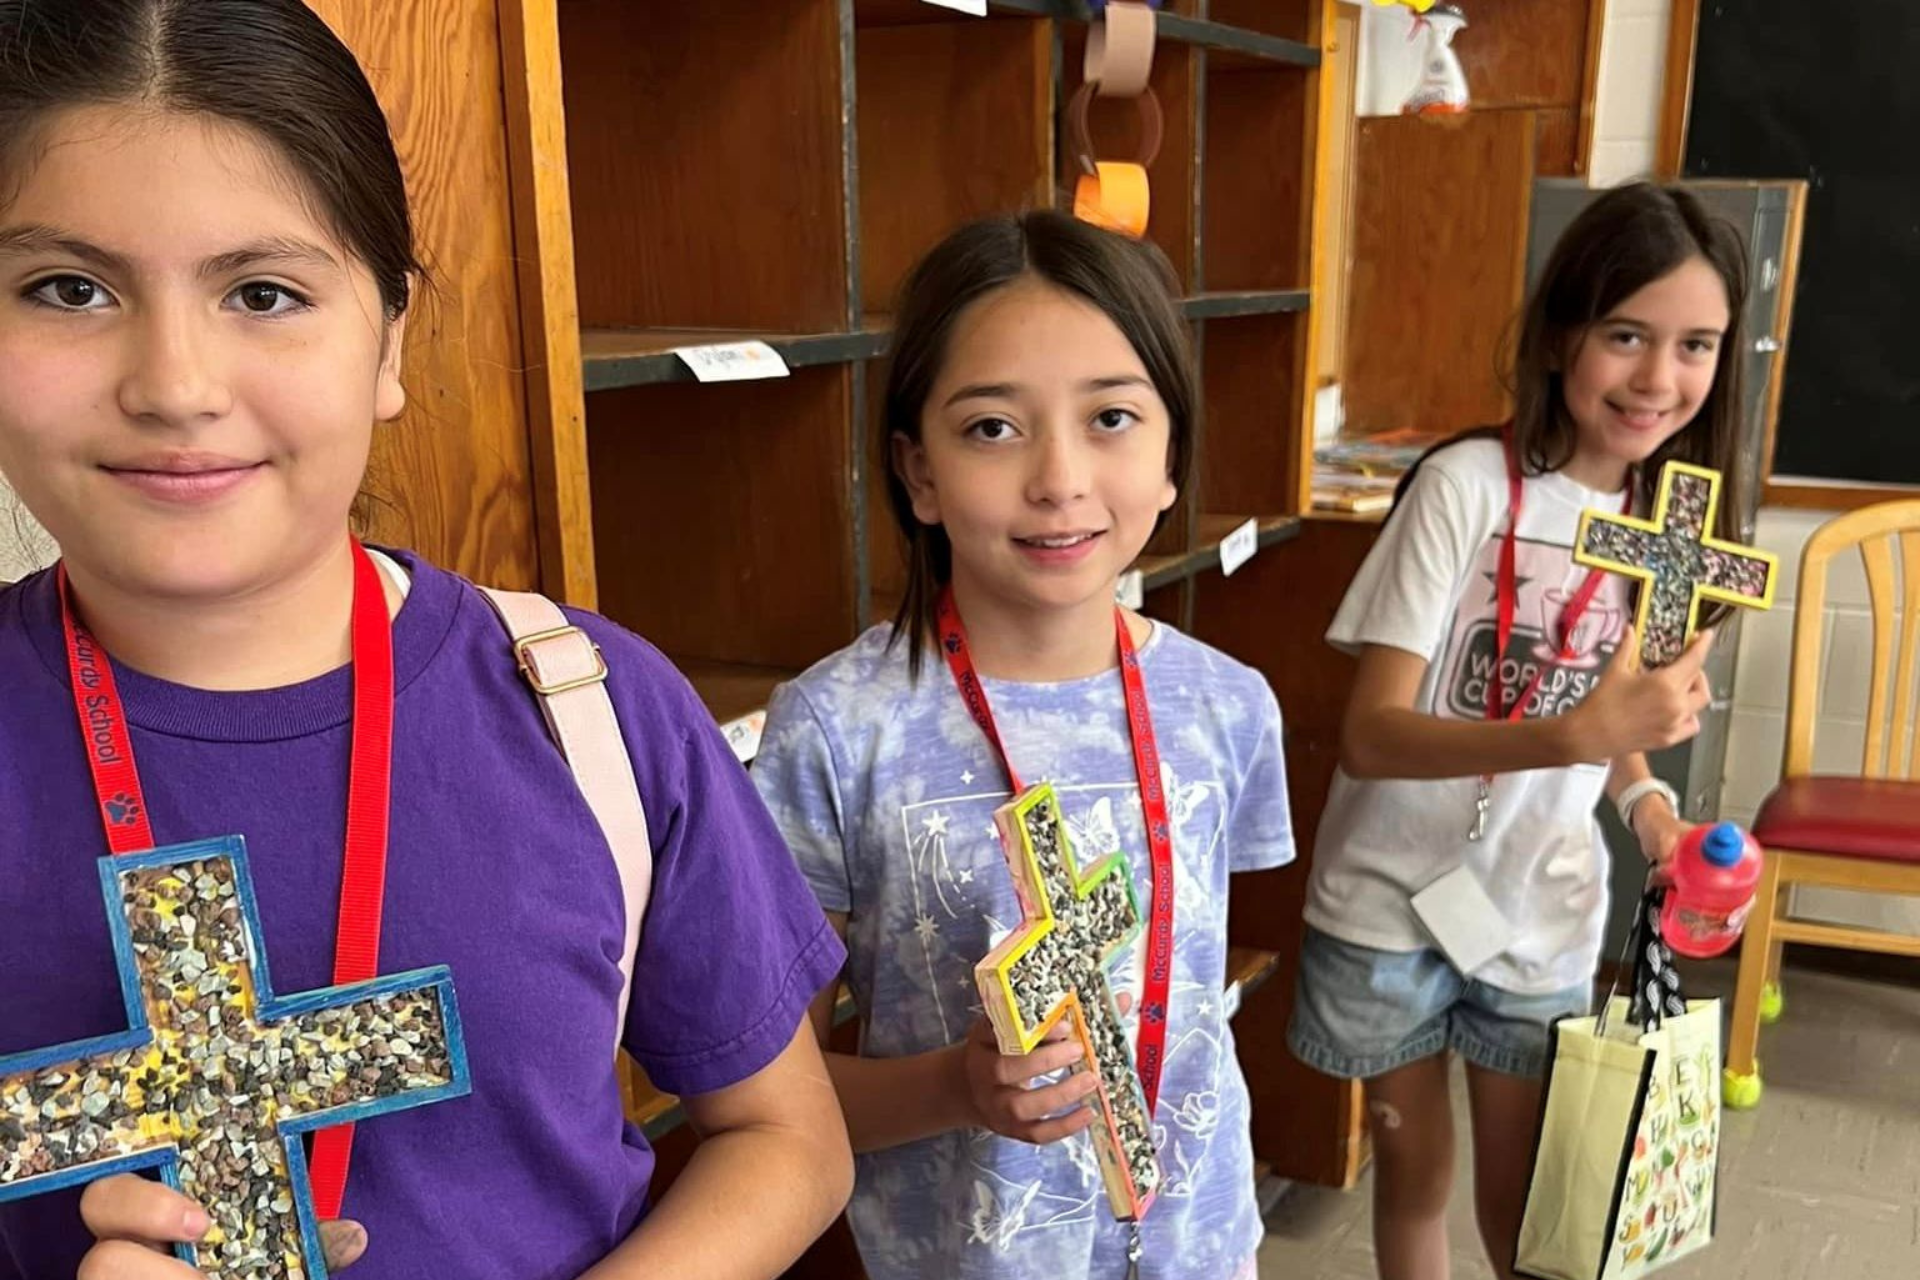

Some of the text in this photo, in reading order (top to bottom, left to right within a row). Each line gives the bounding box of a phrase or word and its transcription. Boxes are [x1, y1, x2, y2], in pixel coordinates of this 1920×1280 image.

[86, 695, 122, 763] School
[1132, 689, 1160, 801] McCurdy School
[1151, 865, 1171, 981] McCurdy School
[1678, 1089, 1696, 1118] K
